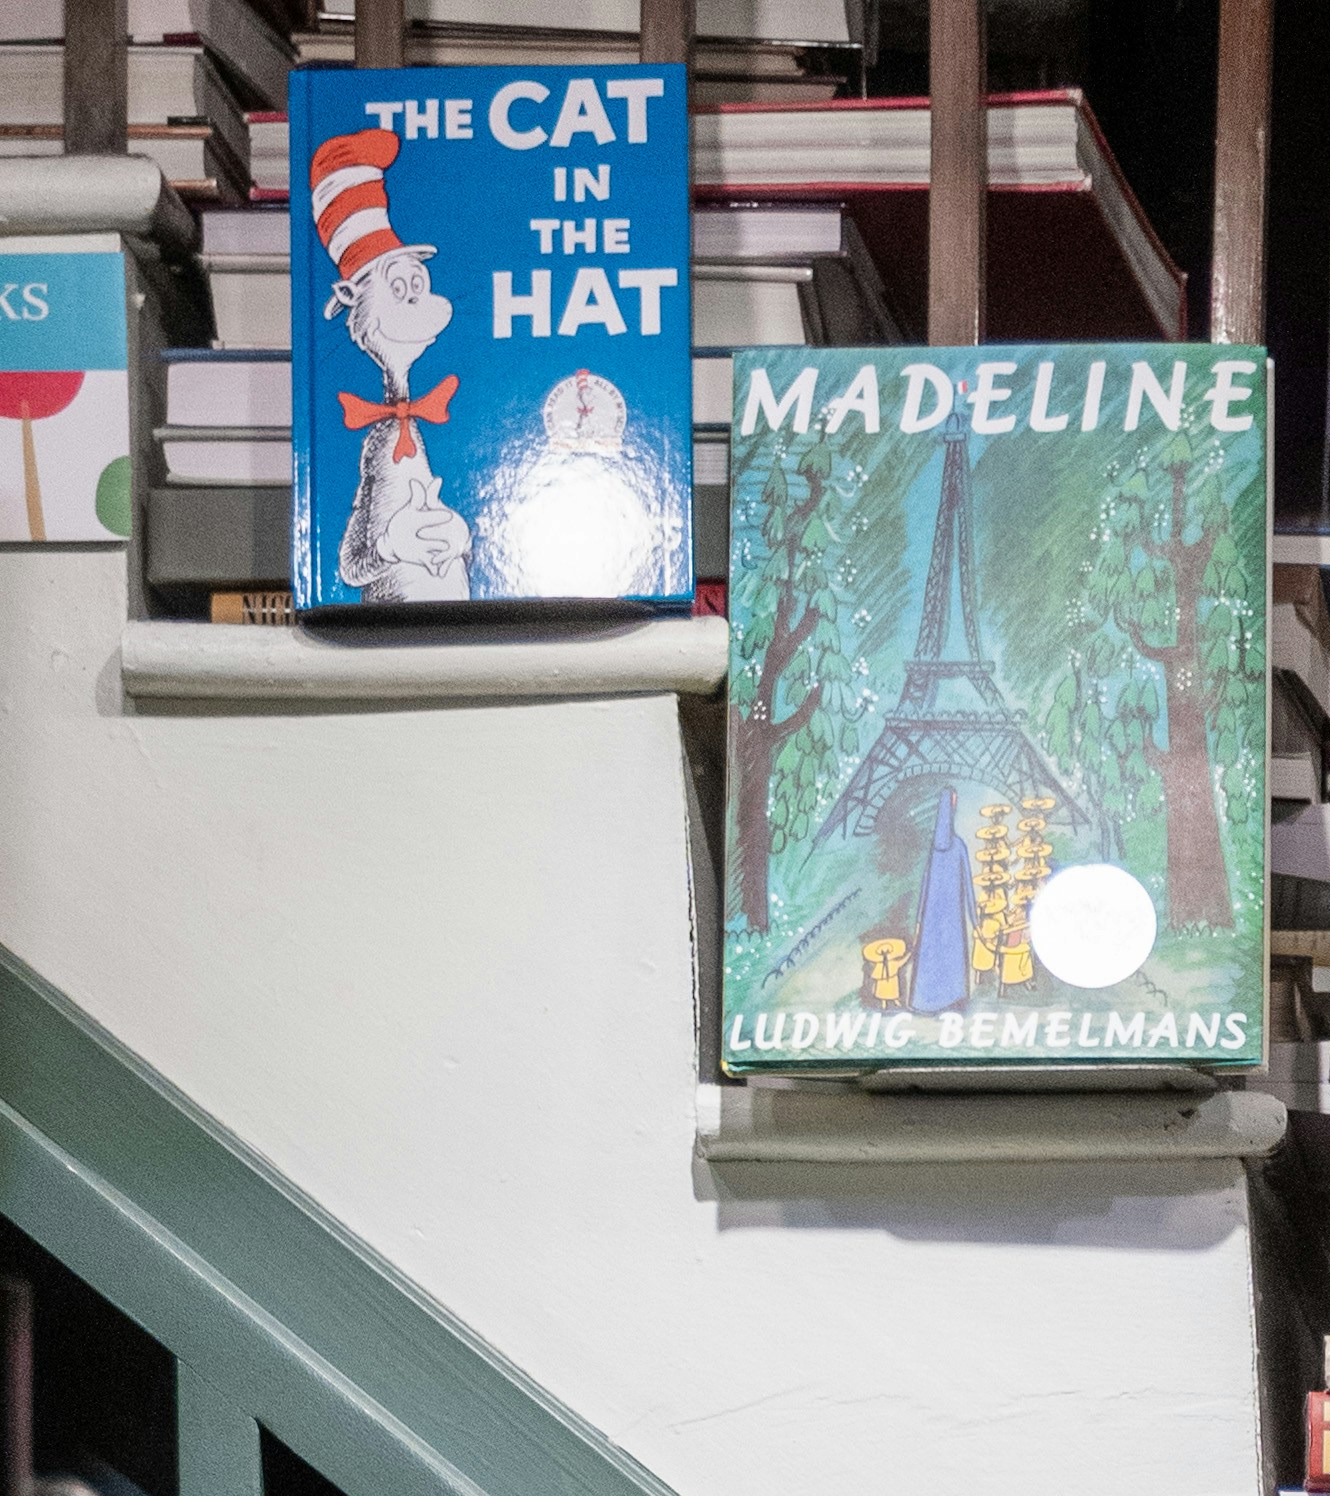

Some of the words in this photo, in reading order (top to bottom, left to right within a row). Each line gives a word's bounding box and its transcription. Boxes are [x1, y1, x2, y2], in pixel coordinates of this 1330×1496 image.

[366, 100, 473, 140] THE
[490, 78, 663, 146] CAT
[554, 166, 610, 201] IN
[530, 217, 631, 254] THE
[493, 269, 677, 338] HAT
[741, 363, 1257, 435] MADELINE
[729, 1011, 914, 1052] LUDWIG
[936, 1010, 1247, 1050] BEMELMANS
